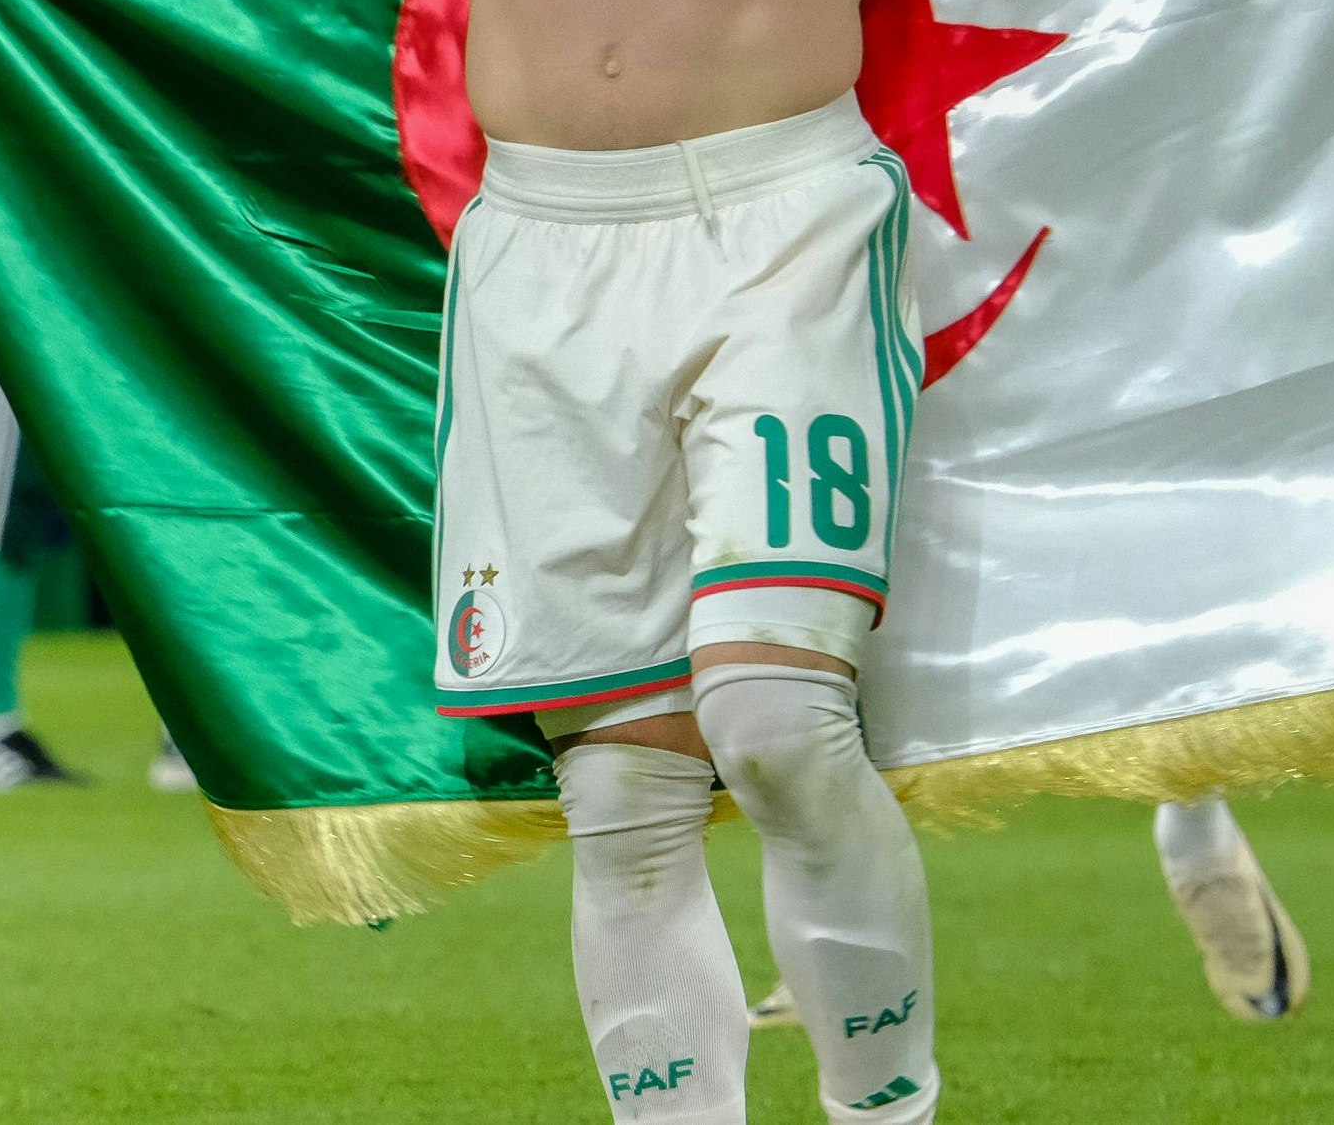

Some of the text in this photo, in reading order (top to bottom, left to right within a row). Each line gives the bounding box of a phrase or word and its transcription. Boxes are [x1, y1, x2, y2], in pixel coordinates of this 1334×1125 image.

[752, 412, 872, 552] 18
[843, 990, 917, 1038] FAF
[609, 1057, 694, 1101] FAF
